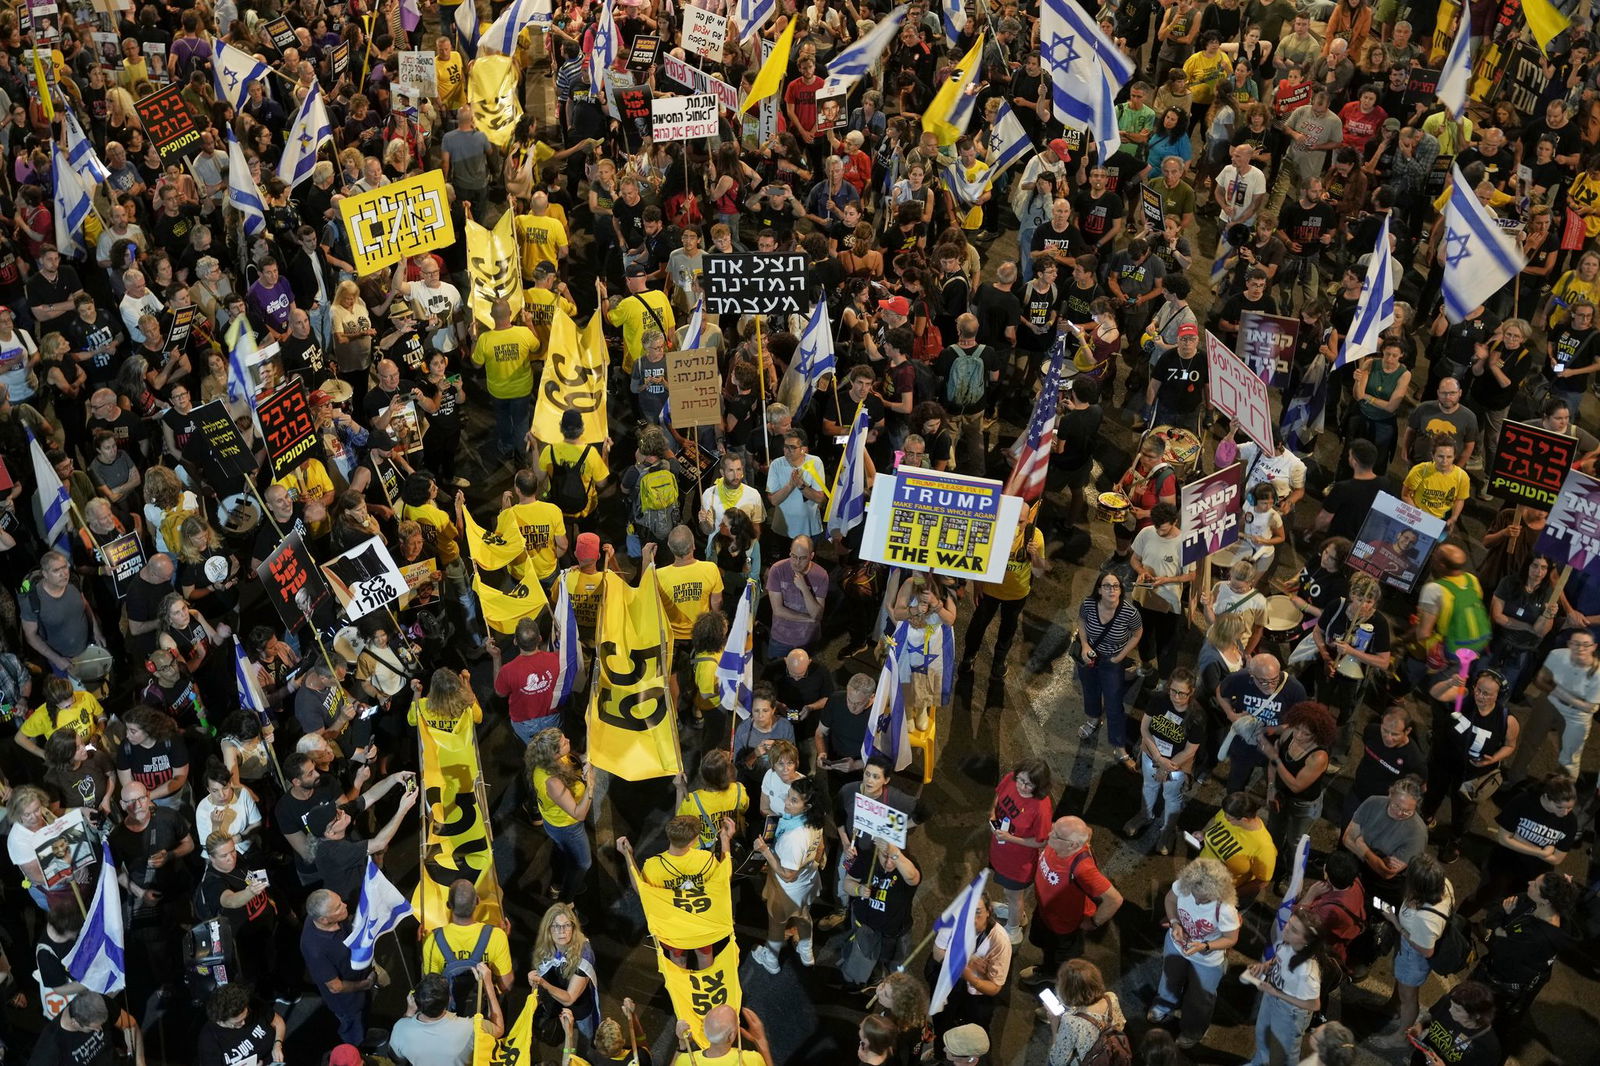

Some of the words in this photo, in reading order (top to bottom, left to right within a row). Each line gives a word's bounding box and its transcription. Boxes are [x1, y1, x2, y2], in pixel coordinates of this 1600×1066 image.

[696, 12, 705, 20] פה
[705, 15, 715, 25] ישן
[712, 31, 722, 40] עם
[708, 42, 719, 52] נקי
[449, 73, 461, 84] 59
[140, 94, 184, 120] ביבי
[685, 95, 715, 110] מתחת
[149, 112, 192, 138] בוגד
[1063, 129, 1080, 138] LAST
[160, 129, 201, 158] בחטופים
[708, 259, 743, 274] את
[753, 256, 805, 273] תציל
[711, 276, 805, 293] המדינה
[707, 295, 800, 315] מעצמך
[1245, 328, 1293, 349] קטאר
[673, 355, 715, 369] מורשת
[674, 370, 714, 383] נתניהו:
[694, 386, 717, 396] בתי
[262, 392, 306, 426] ביבי
[680, 397, 718, 410] קברות
[1219, 376, 1267, 441] חיים
[267, 412, 312, 448] בוגד
[275, 434, 317, 471] בחטופים
[1505, 431, 1568, 466] ביבי
[1500, 452, 1561, 487] בוגד
[911, 479, 937, 487] TRUMP
[937, 482, 964, 491] PLEASE
[902, 486, 993, 511] TRUMP
[1186, 484, 1238, 515] קטאר
[1564, 491, 1600, 518] אר
[893, 501, 914, 509] MAKE
[914, 503, 946, 513] FAMILIES
[947, 507, 973, 517] WHOLE
[973, 512, 996, 520] AGAIN
[889, 509, 993, 558] STOP
[1185, 513, 1237, 548] בגידה
[1546, 521, 1600, 557] גידה
[1352, 547, 1366, 559] HIM
[1356, 540, 1376, 555] BRING
[116, 555, 142, 573] מסרבים
[888, 545, 929, 564] THE
[936, 551, 984, 572] WAR
[351, 580, 390, 608] שחור!
[598, 641, 668, 732] 59
[1206, 821, 1244, 861] NOW
[672, 897, 712, 914] 59
[690, 969, 725, 993] צו
[691, 987, 728, 1016] 59
[251, 1024, 267, 1039] אני
